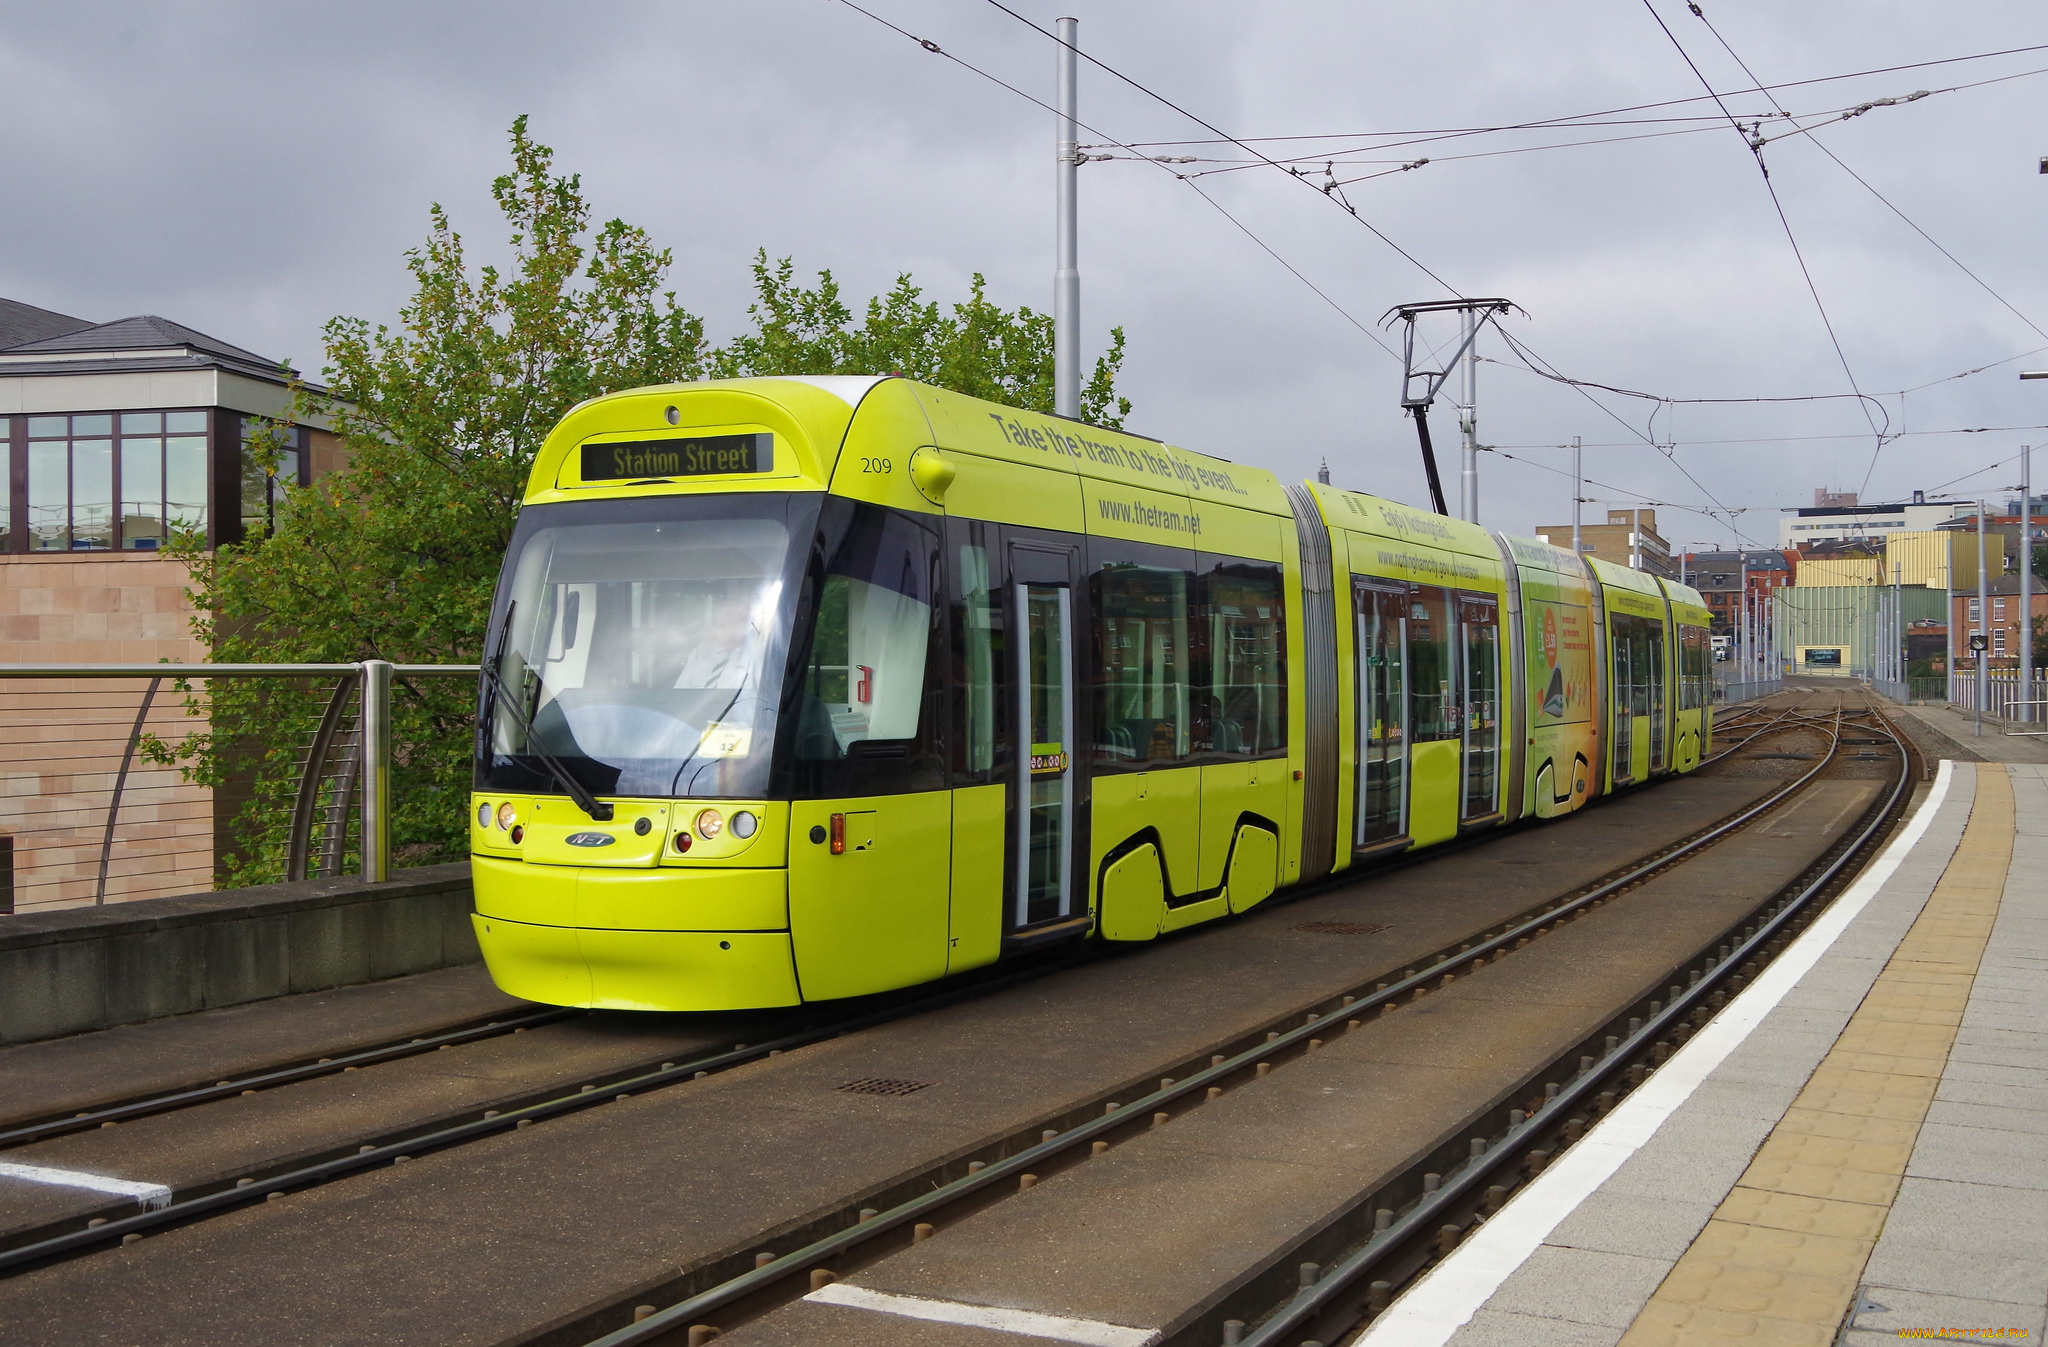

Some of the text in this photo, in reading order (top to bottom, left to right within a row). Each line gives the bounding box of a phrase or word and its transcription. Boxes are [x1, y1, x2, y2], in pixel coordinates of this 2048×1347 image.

[613, 441, 749, 475] Station Street
[860, 457, 892, 474] 209
[989, 412, 1049, 452] Take
[1041, 424, 1082, 458] the
[1074, 432, 1125, 467] tram
[1119, 444, 1144, 472] to
[1139, 449, 1172, 478] the
[1165, 454, 1200, 491] big
[1098, 499, 1202, 535] www.thetram.net
[1378, 505, 1409, 541] Enjoy
[720, 743, 735, 752] 12
[571, 834, 611, 845] NET
